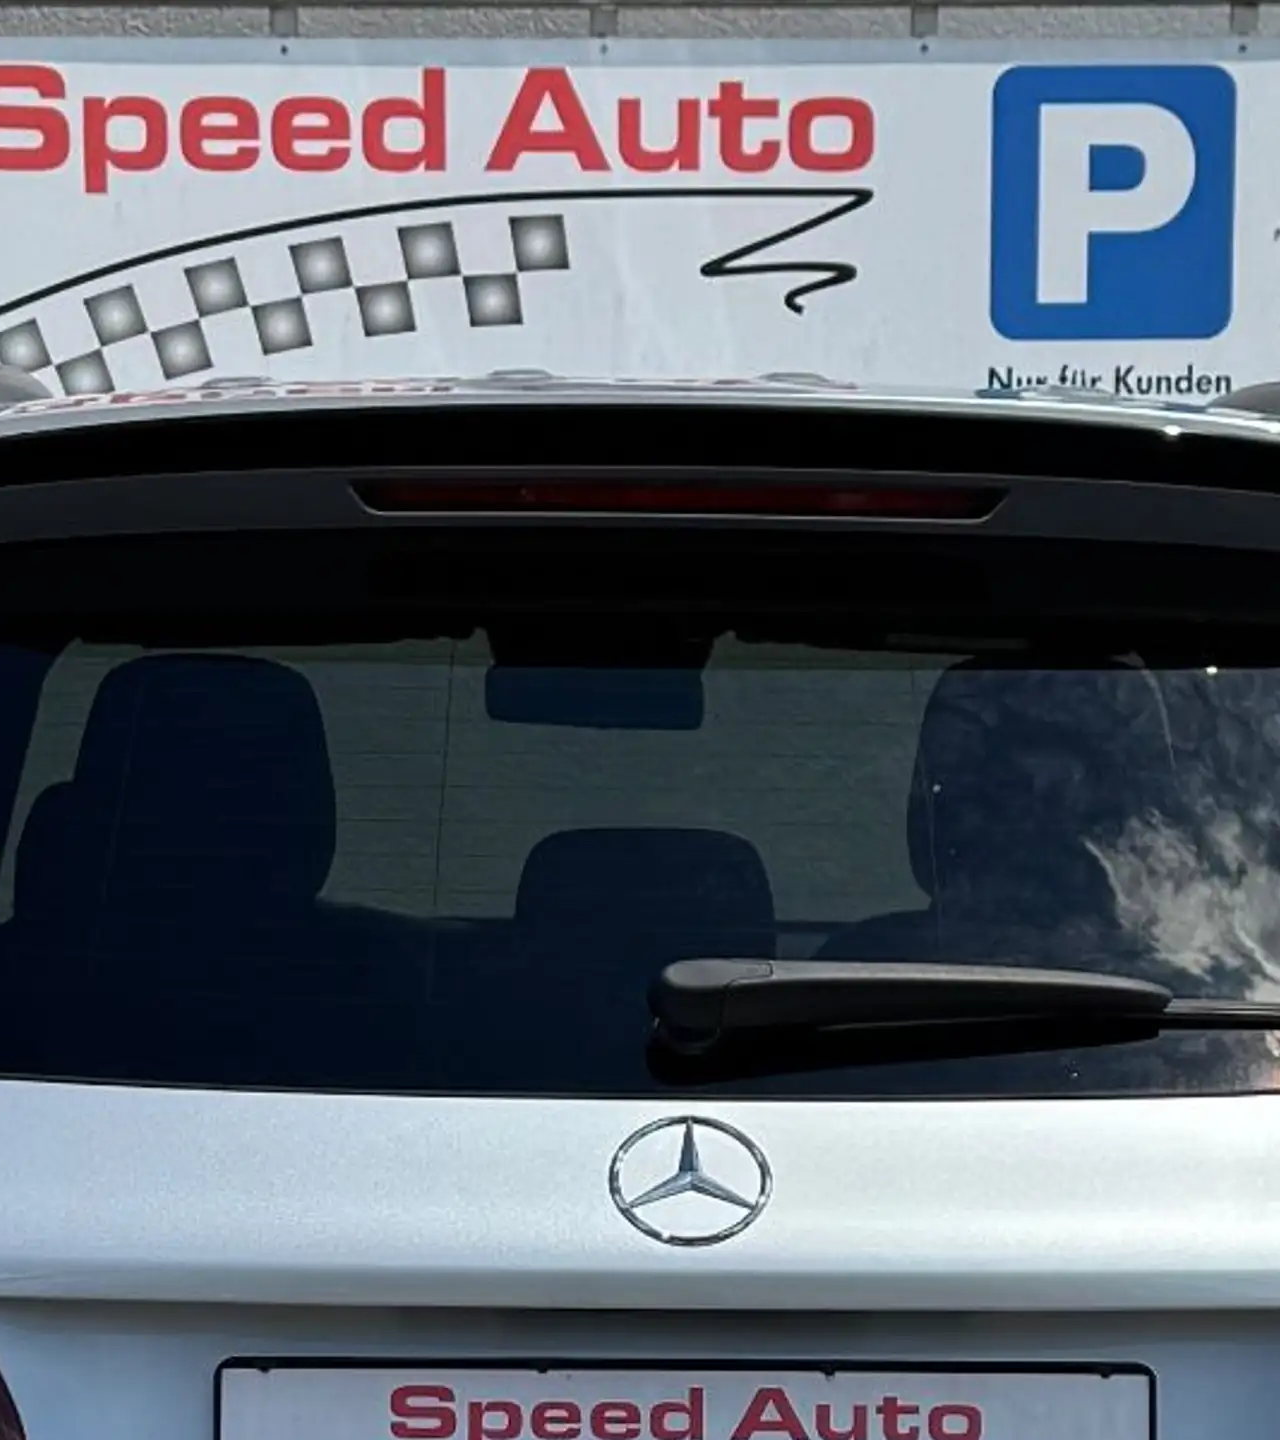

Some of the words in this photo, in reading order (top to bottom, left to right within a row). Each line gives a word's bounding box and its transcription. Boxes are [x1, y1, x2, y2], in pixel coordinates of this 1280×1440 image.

[486, 66, 876, 174] Auto
[1035, 102, 1197, 304] P
[1114, 364, 1233, 396] Kunden
